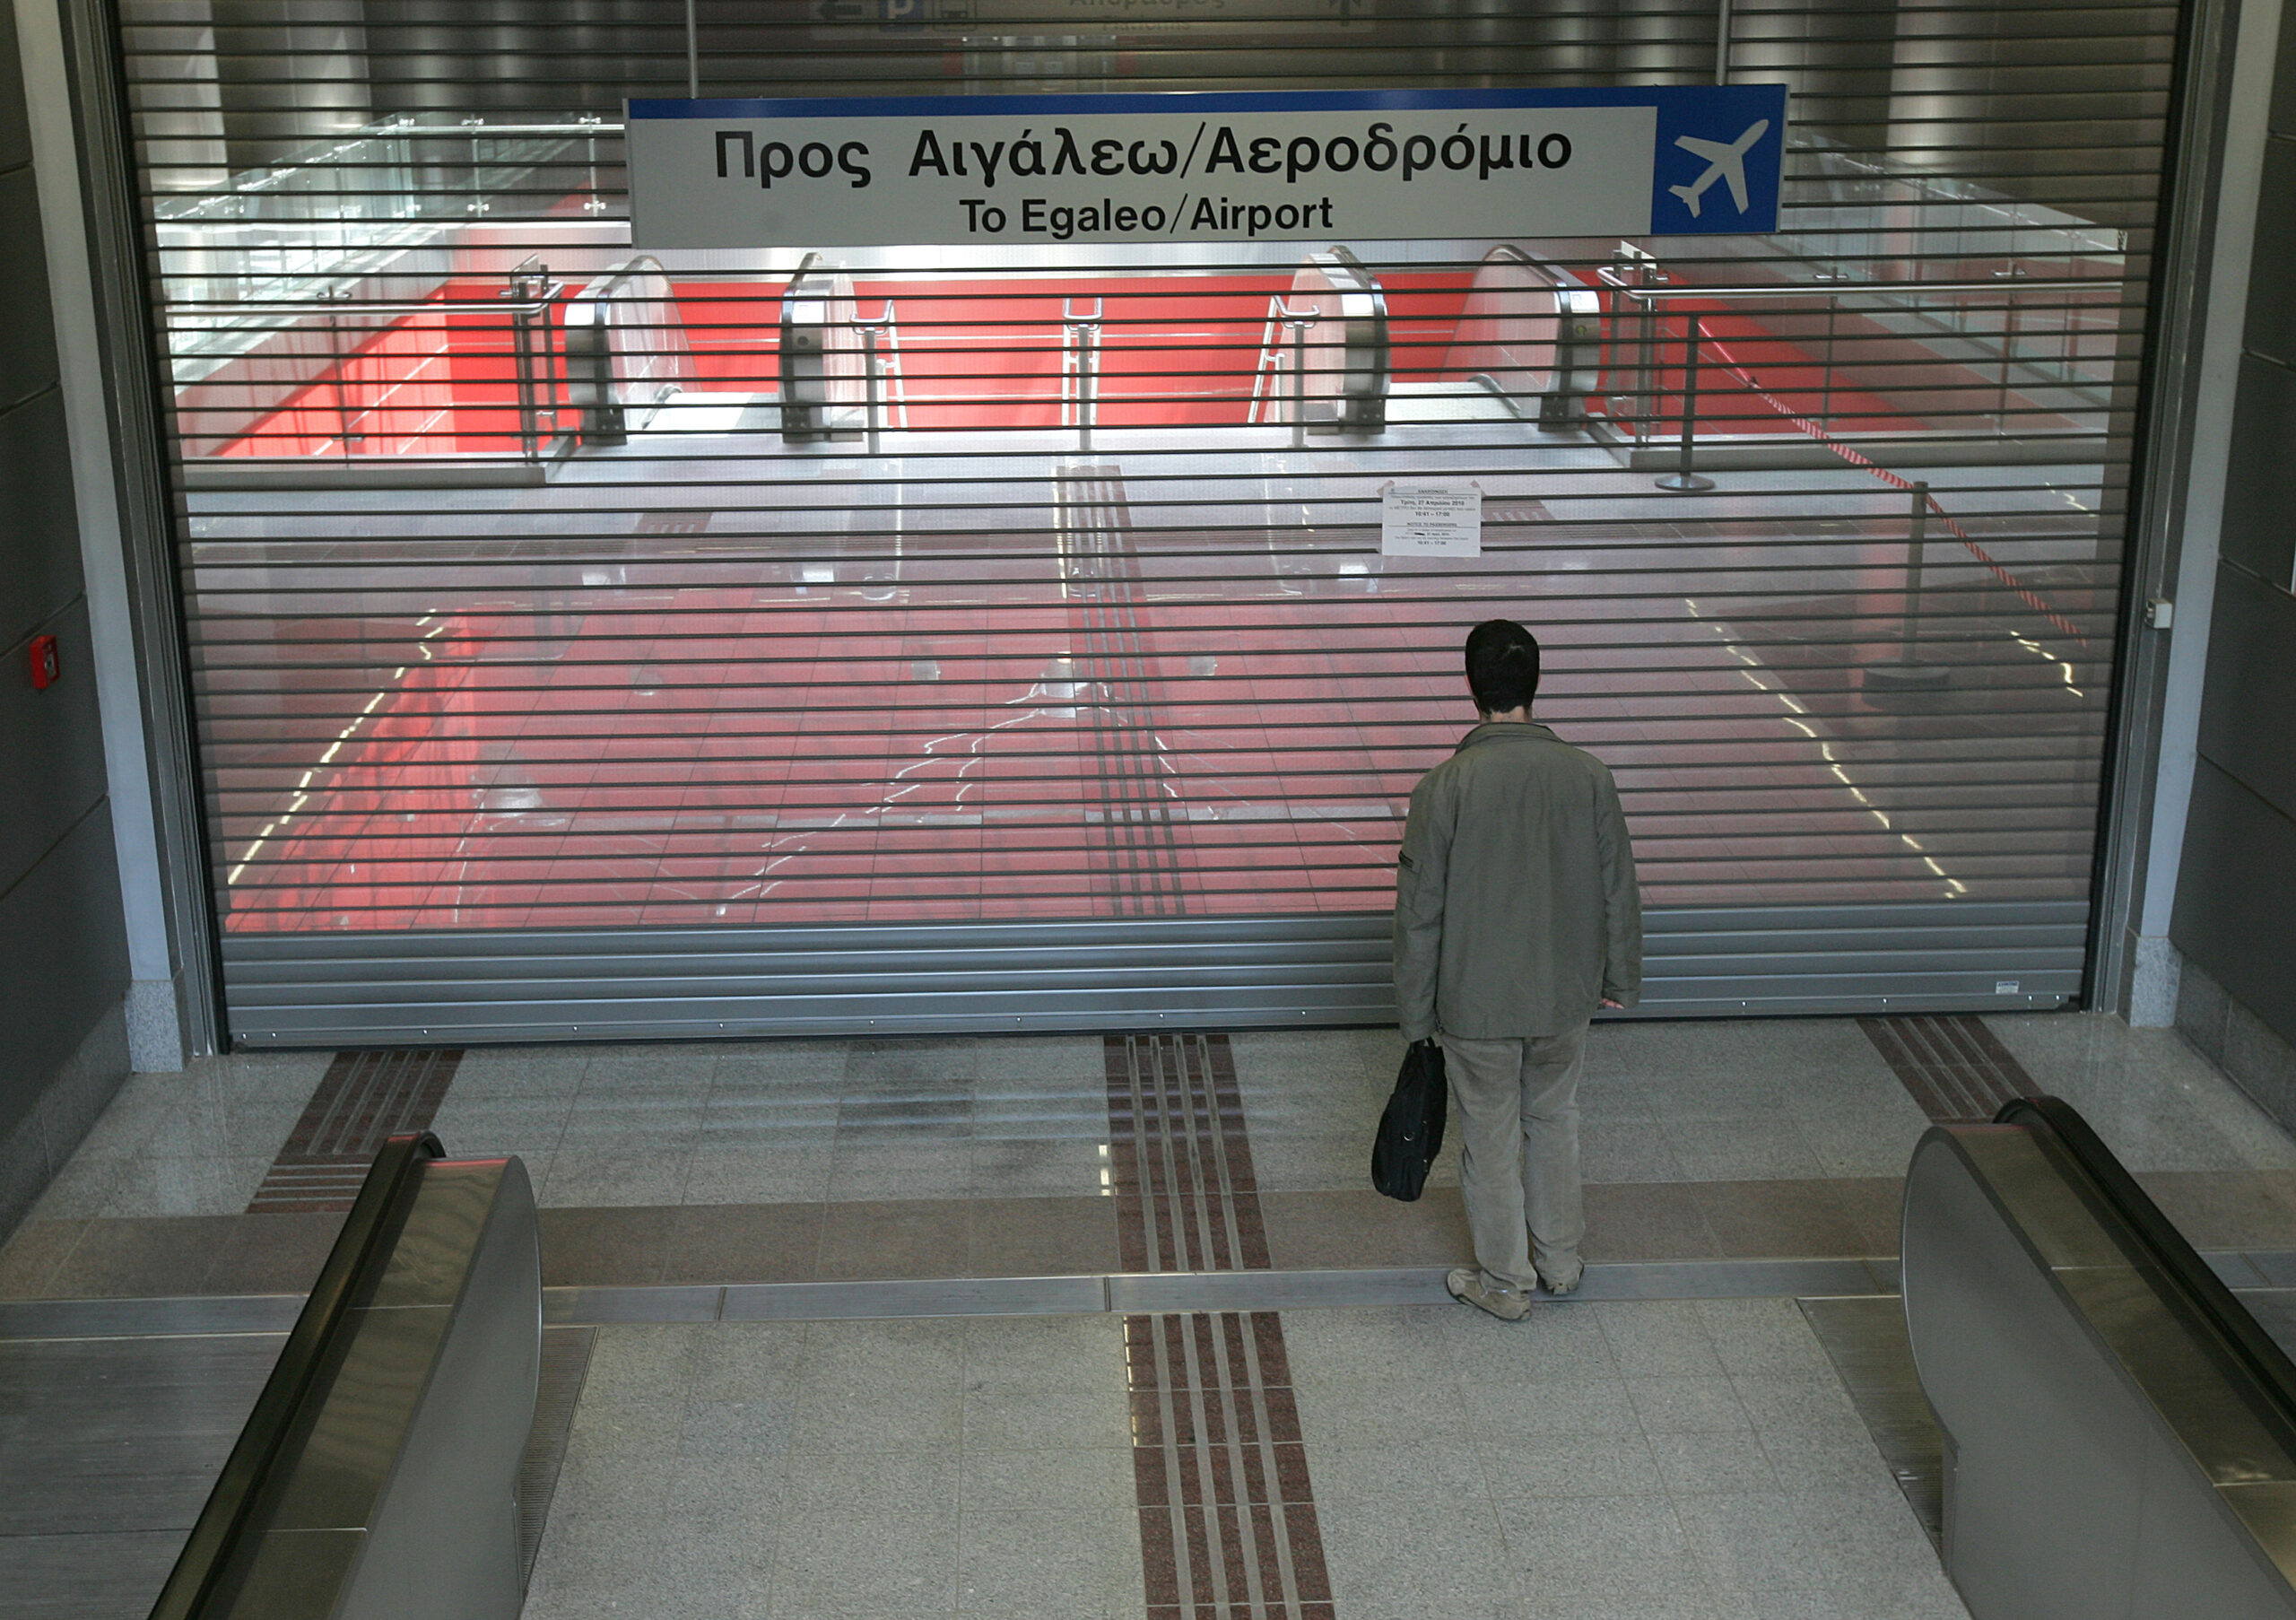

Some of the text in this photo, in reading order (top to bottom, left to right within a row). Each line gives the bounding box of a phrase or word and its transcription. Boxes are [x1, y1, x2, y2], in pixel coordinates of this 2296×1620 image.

[715, 121, 1572, 189] Προς Αιγάλεω/Αεροδρόμιο
[959, 193, 1334, 240] To Egaleo/Airport
